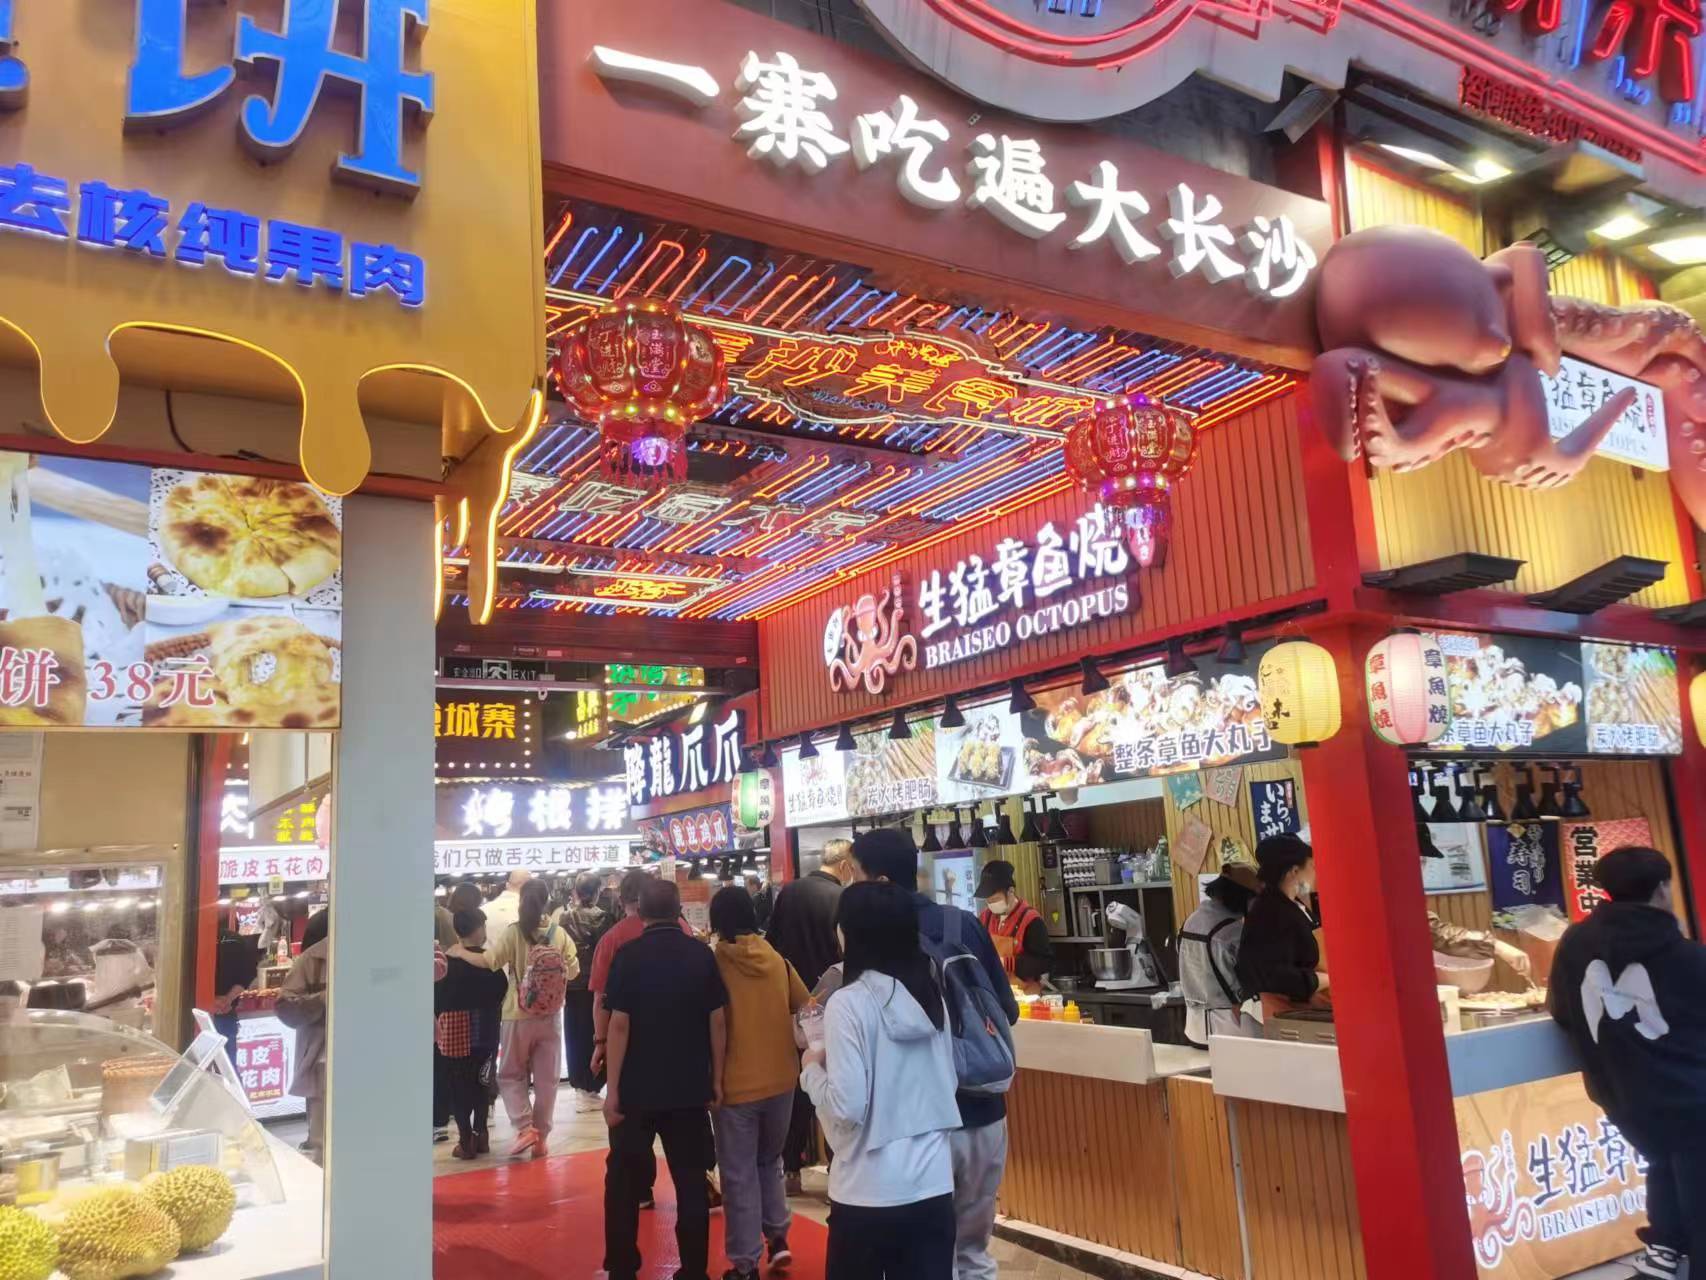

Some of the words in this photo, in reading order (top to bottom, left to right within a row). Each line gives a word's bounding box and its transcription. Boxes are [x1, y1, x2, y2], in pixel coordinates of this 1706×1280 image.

[589, 45, 1317, 298] 一寨吃遍大长沙
[0, 163, 426, 307] 去核纯果肉
[918, 502, 1129, 637] 生猛章鱼烧
[1016, 583, 1129, 639] OCTOPUS
[0, 647, 60, 707] 饼
[90, 655, 216, 707] 38元
[512, 669, 536, 680] EXIT
[623, 709, 741, 804] 降龍爪爪
[1114, 721, 1271, 773] 整条章鱼大丸子
[867, 777, 933, 806] 炭火烤肥肠
[220, 856, 323, 879] 脆皮五花肉
